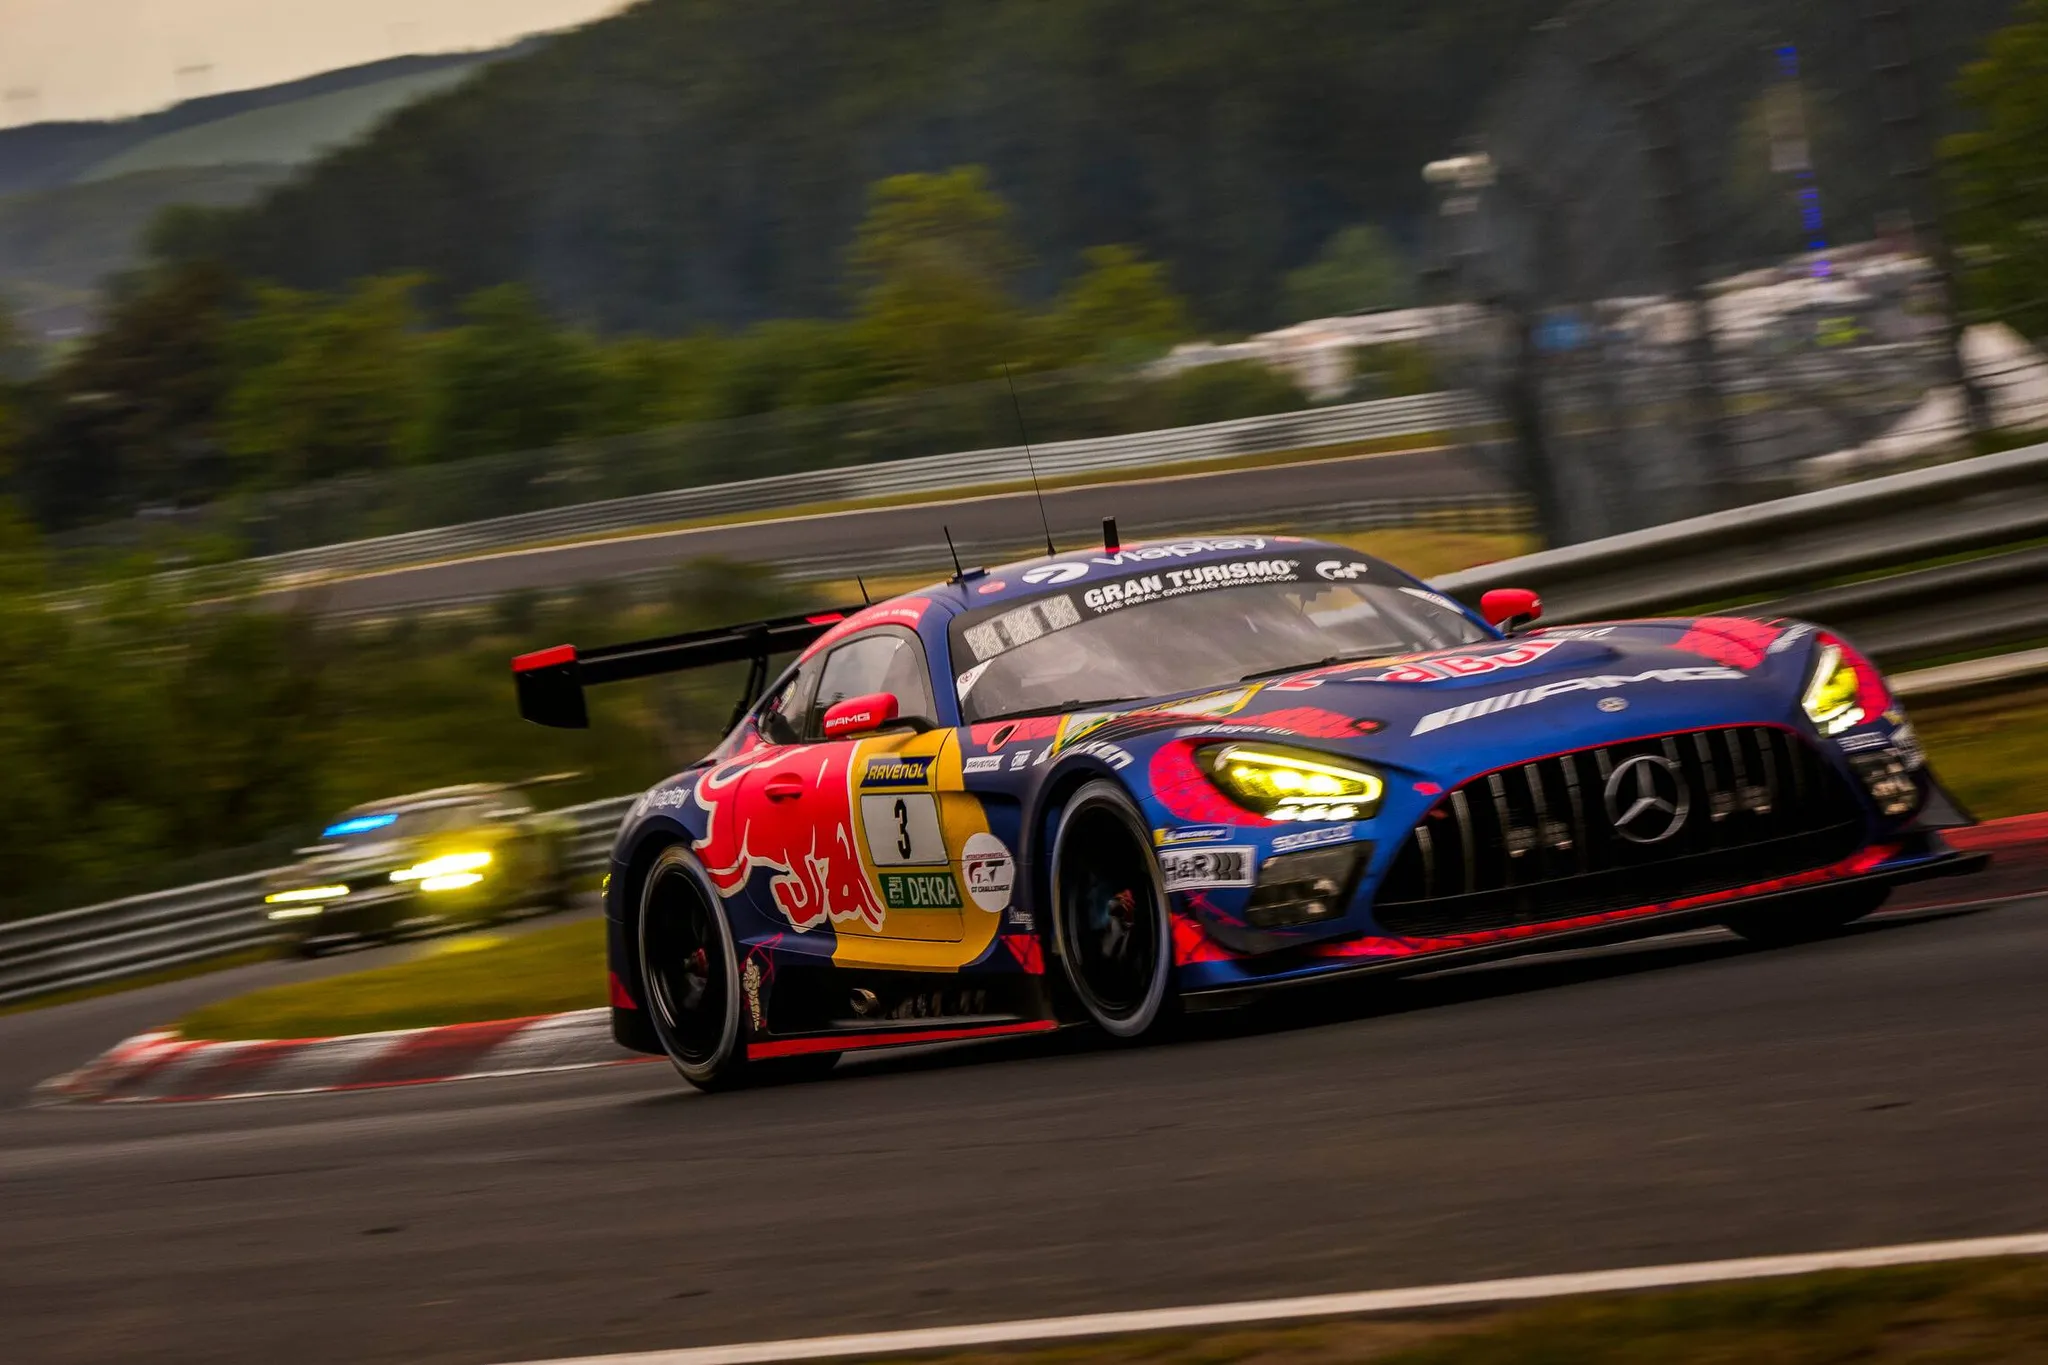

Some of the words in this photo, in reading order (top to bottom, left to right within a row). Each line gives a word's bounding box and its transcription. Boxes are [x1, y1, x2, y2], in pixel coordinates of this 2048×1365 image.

[1084, 574, 1163, 608] GRAN
[1093, 600, 1124, 614] THE
[1124, 592, 1162, 606] REAL
[1162, 580, 1219, 597] DRIVING
[1220, 573, 1299, 588] SIMULATOR
[834, 711, 871, 726] AMG
[868, 763, 924, 780] RAVENOL
[894, 799, 911, 860] 3
[908, 876, 960, 905] DEKRA
